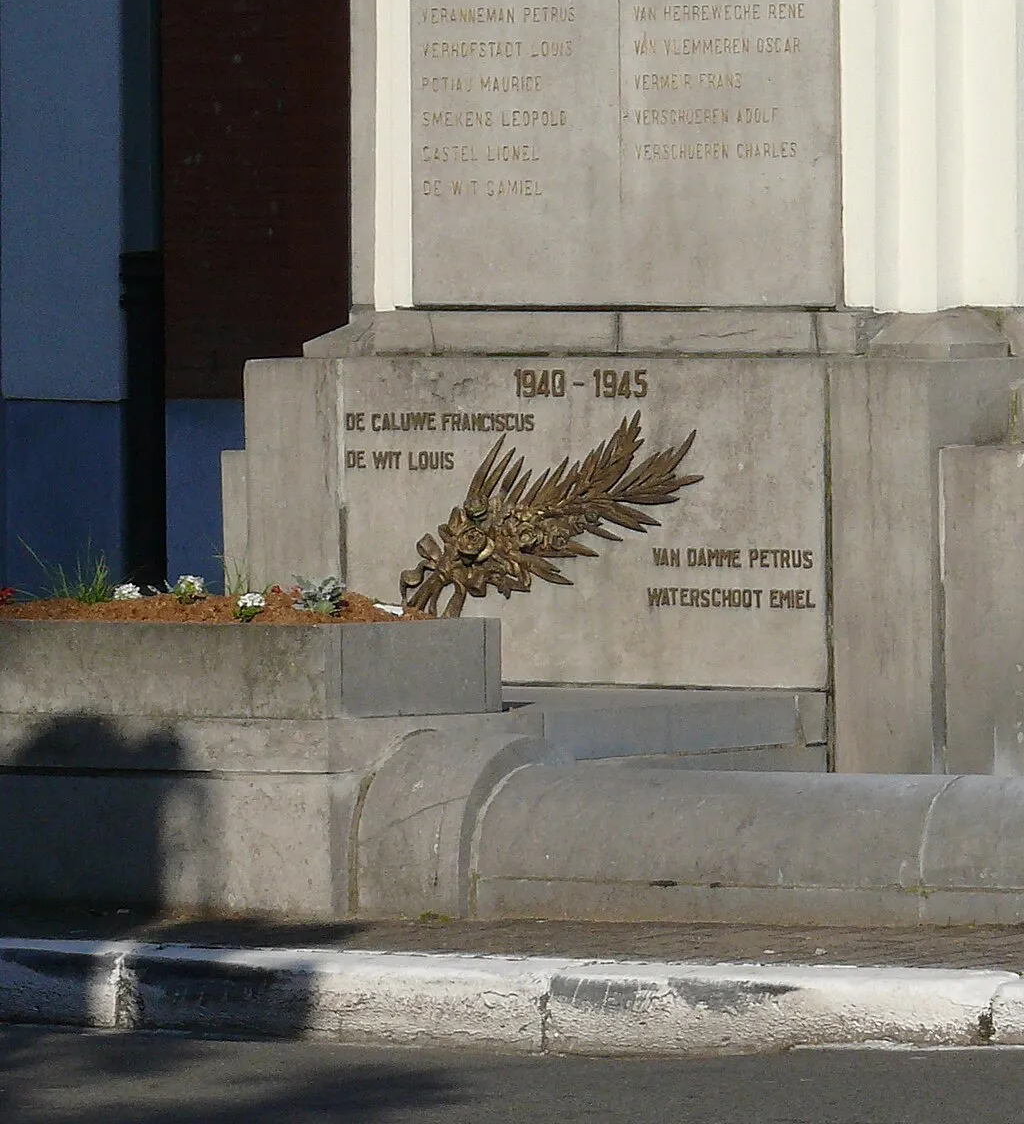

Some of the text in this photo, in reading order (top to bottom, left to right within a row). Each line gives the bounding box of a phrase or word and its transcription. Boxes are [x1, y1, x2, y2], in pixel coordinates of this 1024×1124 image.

[421, 6, 576, 24] VERANNEMAN PETRUS
[634, 5, 656, 22] VAN
[768, 3, 805, 19] RENE
[422, 40, 573, 58] VERHOFSTADT LOUIS
[634, 37, 801, 55] VAN VLEMMEREN OSCAR
[480, 75, 542, 92] MAURICE
[700, 73, 742, 89] FRANS
[422, 110, 568, 127] SMEKENS LEOPOLD
[634, 107, 778, 126] VERSCHUEREN ADOLF
[422, 145, 540, 162] CASTEL LIONEL
[635, 141, 797, 160] VERSCHUEREN CHARLES
[423, 180, 441, 196] DE
[513, 369, 565, 397] 1940
[593, 369, 647, 398] 1945
[346, 412, 535, 432] DE CALUWE FRANCISCUS
[346, 450, 454, 470] DE WIT LOUIS
[652, 547, 813, 569] VAN DAMME PETRUS
[647, 587, 816, 609] WATERSCHOOT EMIEL
